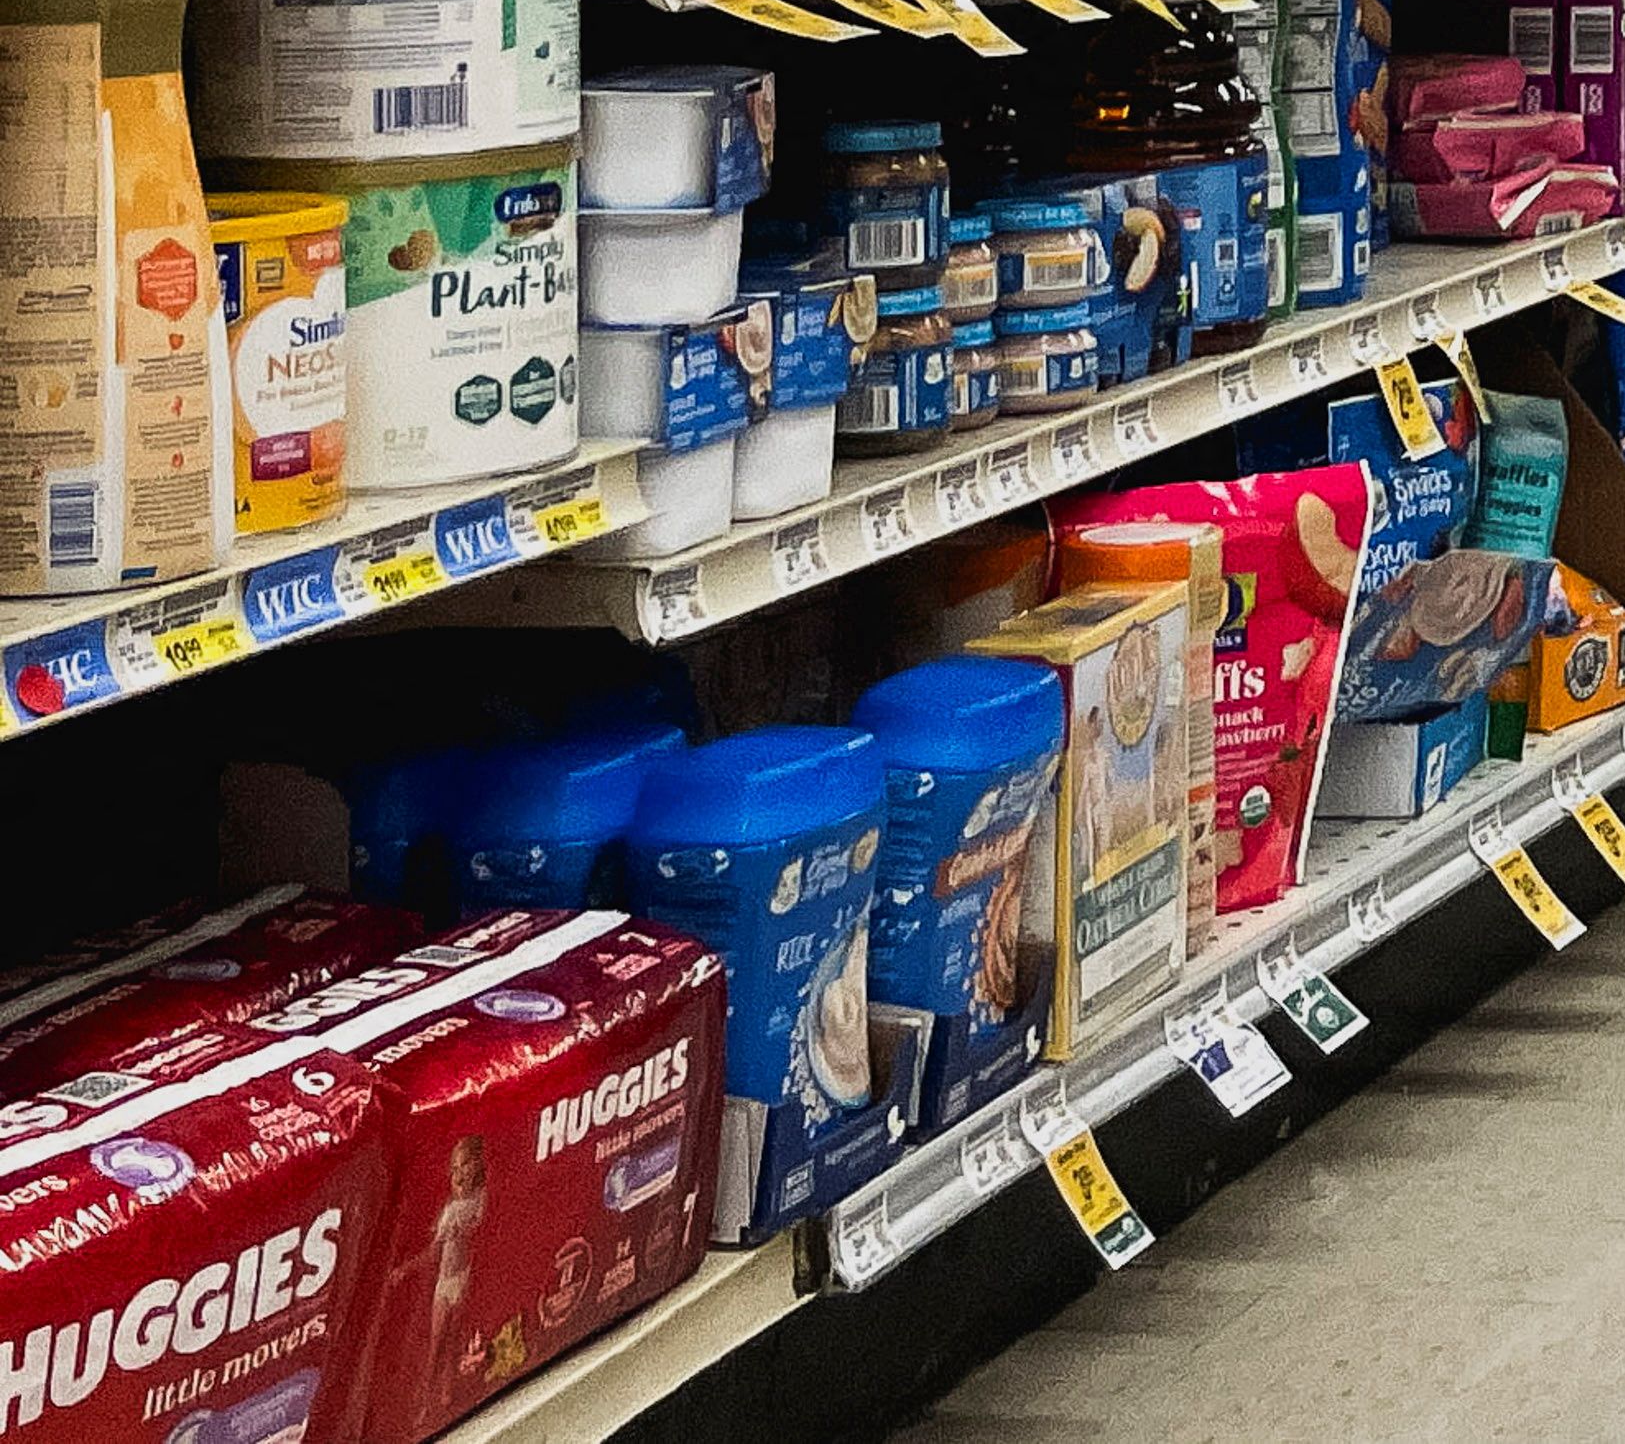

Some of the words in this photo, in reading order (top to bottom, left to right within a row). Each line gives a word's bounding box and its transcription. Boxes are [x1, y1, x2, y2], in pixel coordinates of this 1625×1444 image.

[494, 241, 565, 268] Simply
[444, 515, 507, 568] WIC
[256, 574, 323, 628] WIC
[291, 1067, 337, 1097] 6
[534, 1036, 691, 1164] HUGGIES
[0, 1208, 342, 1439] HUGGIES
[141, 1355, 218, 1424] little
[221, 1314, 329, 1392] movers
